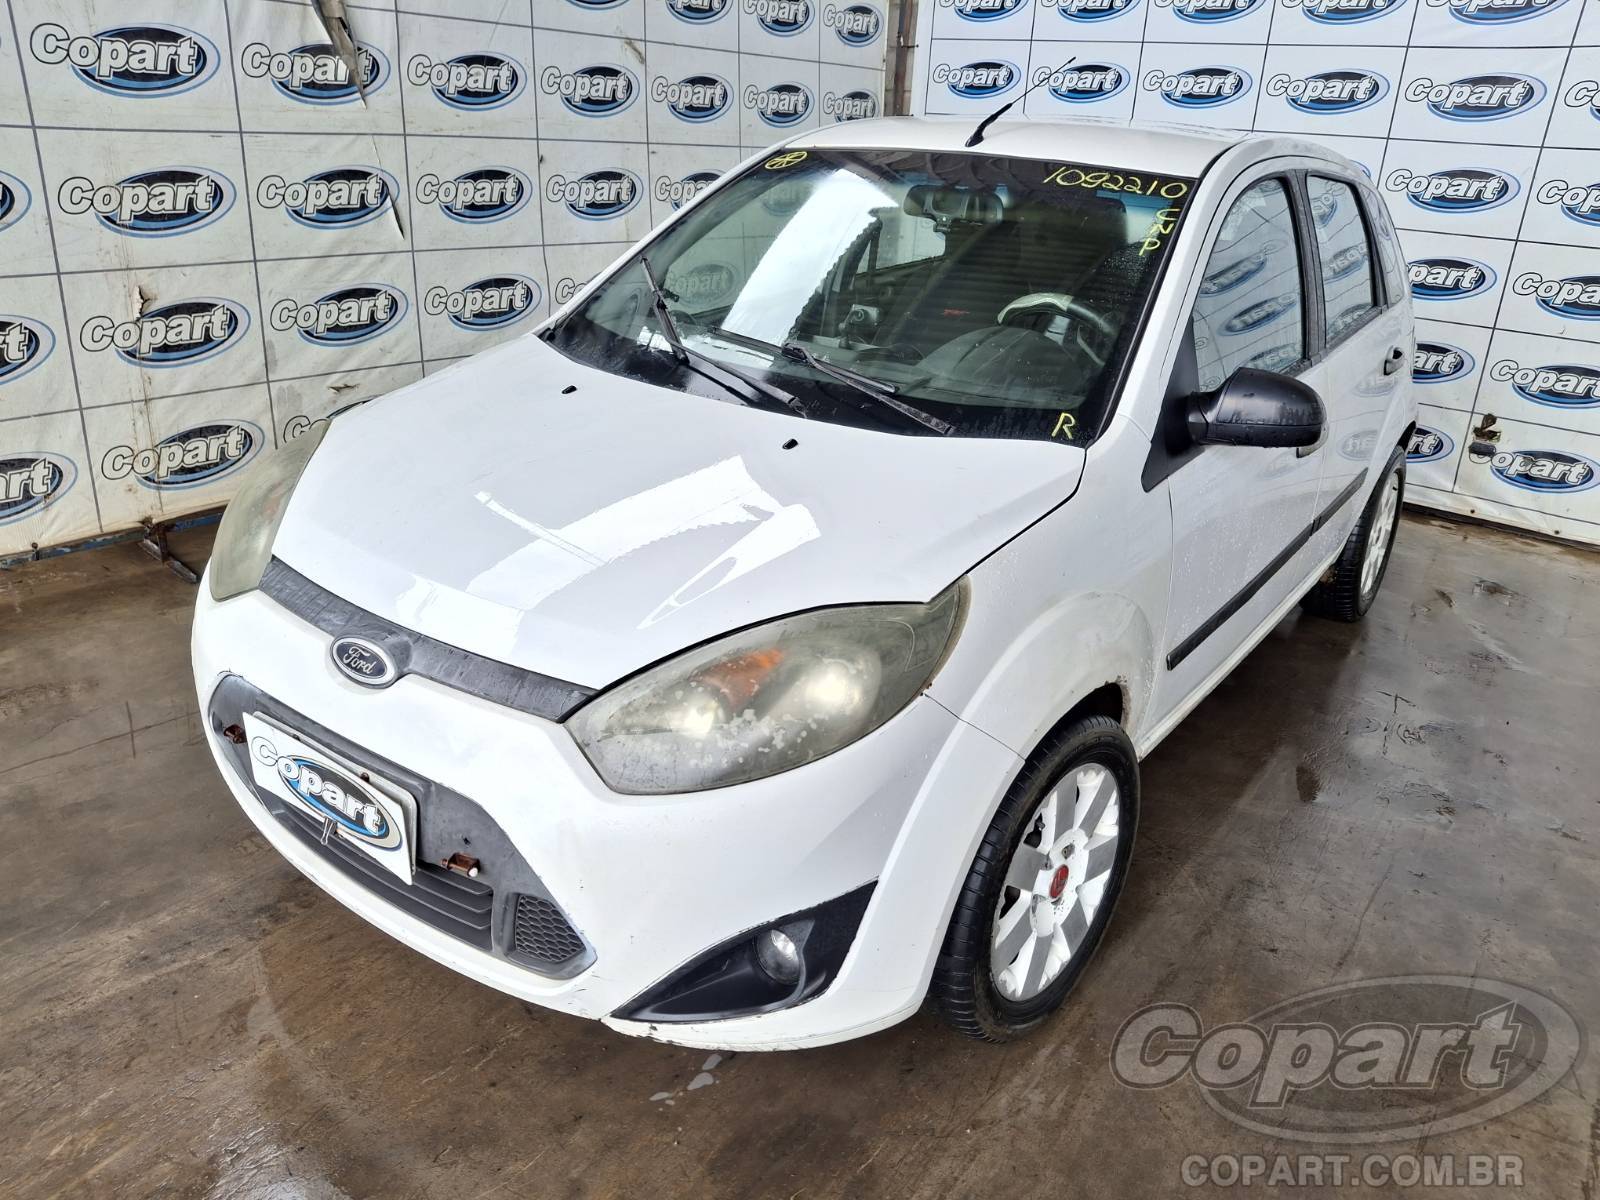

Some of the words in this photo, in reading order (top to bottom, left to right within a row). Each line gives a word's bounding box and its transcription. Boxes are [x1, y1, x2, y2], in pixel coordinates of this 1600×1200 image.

[823, 4, 877, 34] Copart
[30, 23, 198, 78] Copart
[407, 54, 512, 96] Copart
[541, 66, 628, 103] Copart
[933, 64, 1010, 88] Copart
[1032, 66, 1120, 92] Copart
[1143, 70, 1241, 99] Copart
[1266, 74, 1375, 104] Copart
[651, 75, 725, 110] Copart
[743, 84, 807, 115] Copart
[823, 92, 874, 121] Copart
[1405, 78, 1530, 110] Copart
[257, 174, 384, 216] Copart
[416, 174, 518, 210] Copart
[546, 174, 632, 209] Copart
[655, 175, 713, 202] Cop
[1043, 167, 1188, 198] 1092210
[1386, 168, 1504, 200] Copart
[1537, 180, 1600, 213] Cop
[58, 176, 214, 223] Copart
[1407, 264, 1481, 291] part
[1512, 272, 1600, 306] Copa
[270, 290, 392, 335] Copart
[424, 280, 527, 320] Copart
[80, 303, 230, 355] Copart
[1412, 349, 1461, 375] art
[1051, 412, 1077, 440] R
[101, 425, 245, 480] Copart
[341, 644, 377, 675] Ford
[250, 735, 382, 836] Copart
